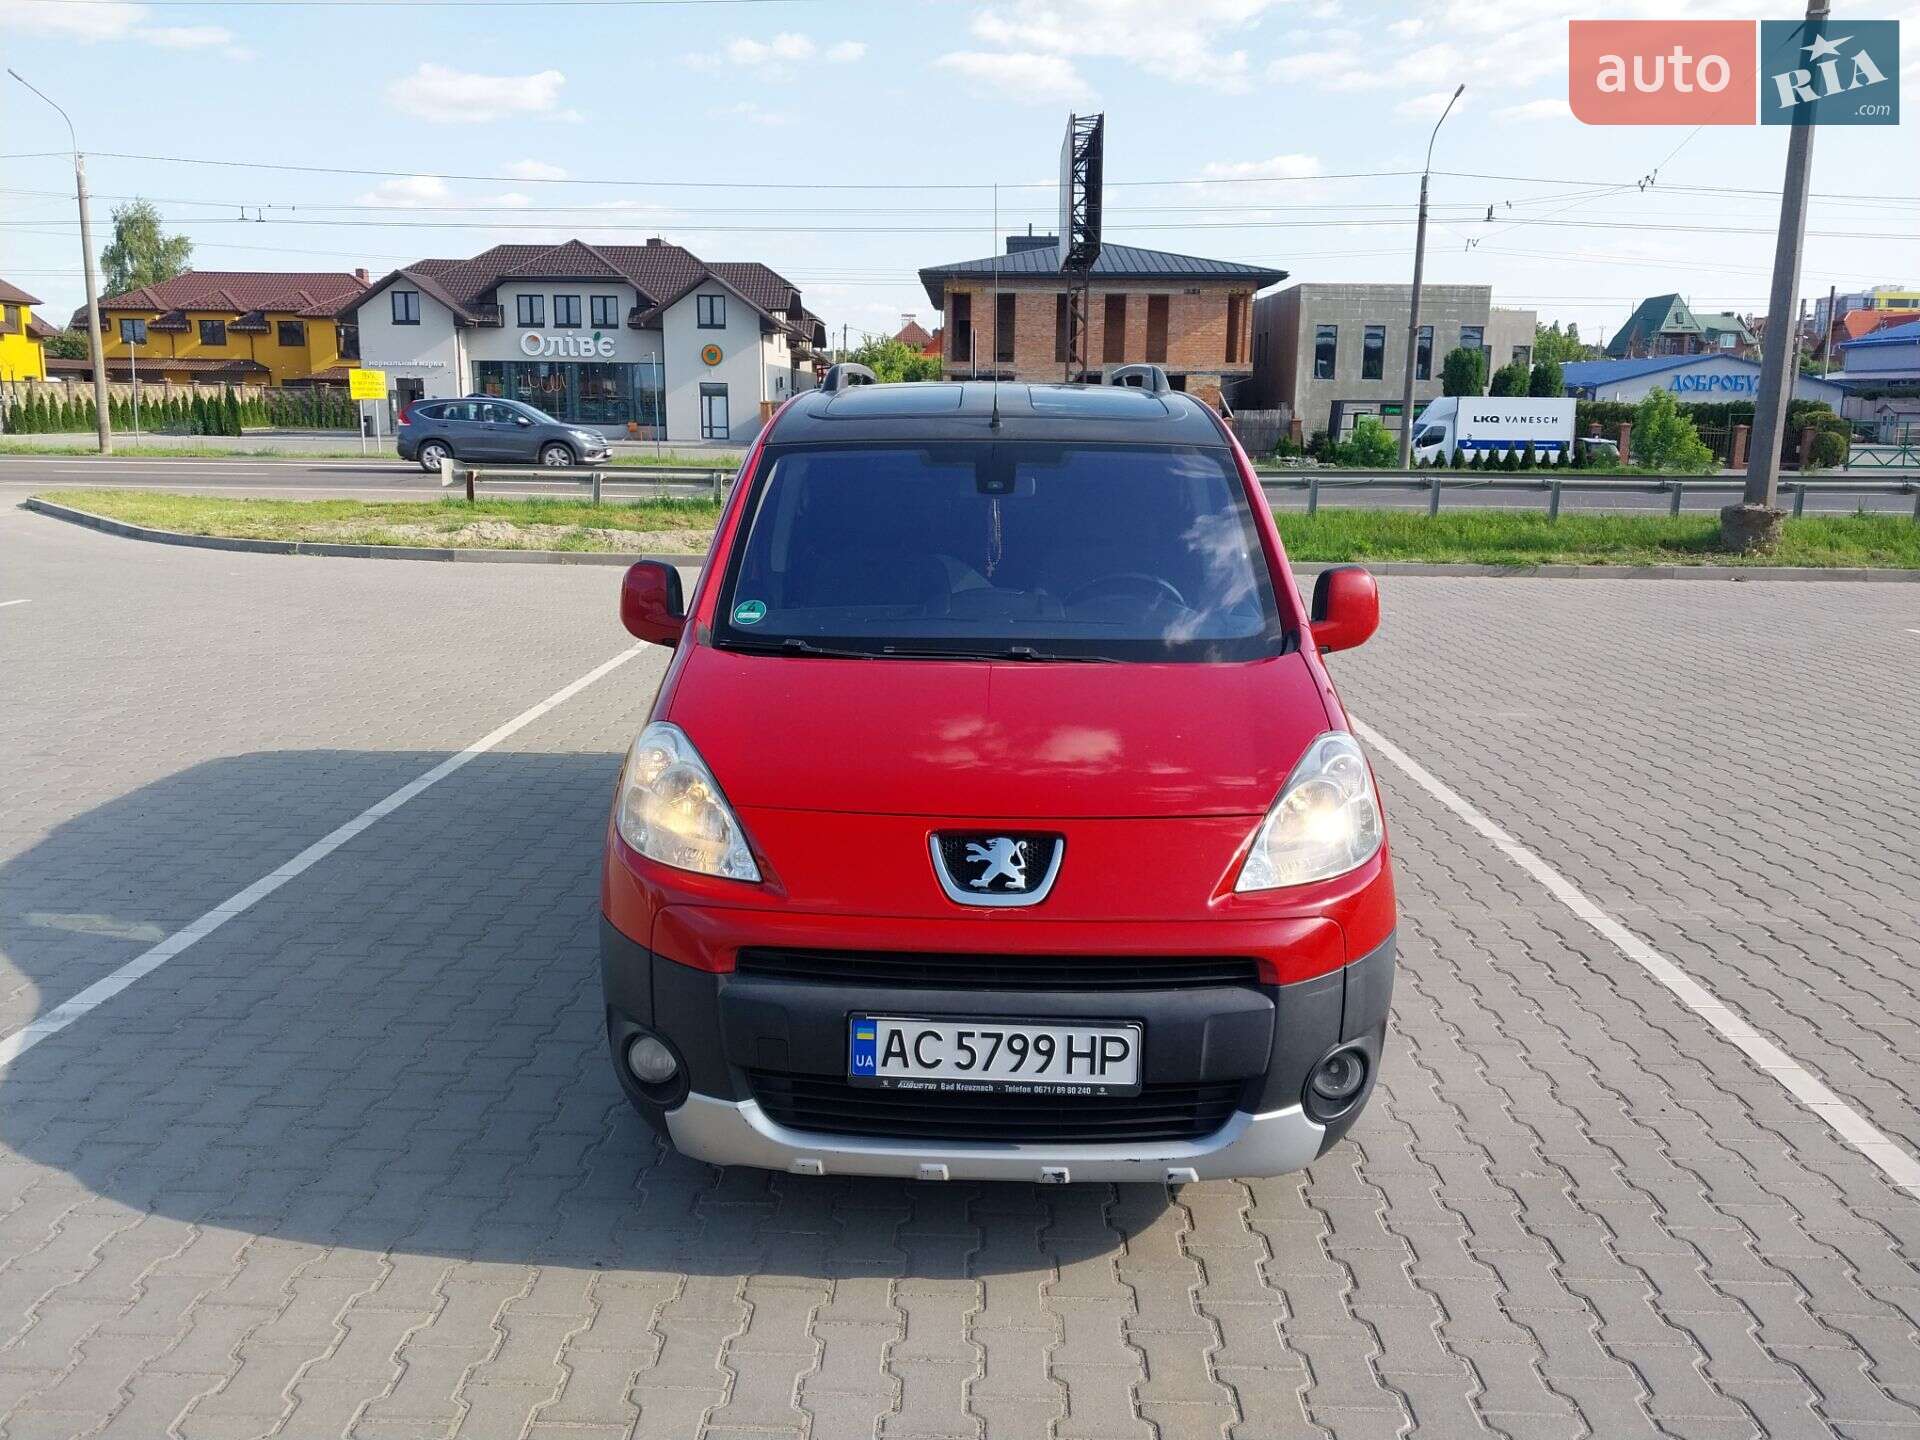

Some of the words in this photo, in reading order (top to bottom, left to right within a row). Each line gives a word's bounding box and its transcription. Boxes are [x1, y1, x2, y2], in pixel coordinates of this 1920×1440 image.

[1669, 374, 1760, 396] ДОБРОБУ
[1473, 415, 1500, 424] LKQ
[1504, 416, 1559, 424] VANESCH
[881, 1028, 944, 1069] AC
[954, 1031, 1056, 1074] 5799
[1065, 1034, 1131, 1075] HP
[855, 1054, 874, 1067] UA
[940, 1082, 955, 1091] Bad
[956, 1082, 994, 1092] Kreuznach
[1005, 1084, 1032, 1094] Telefon
